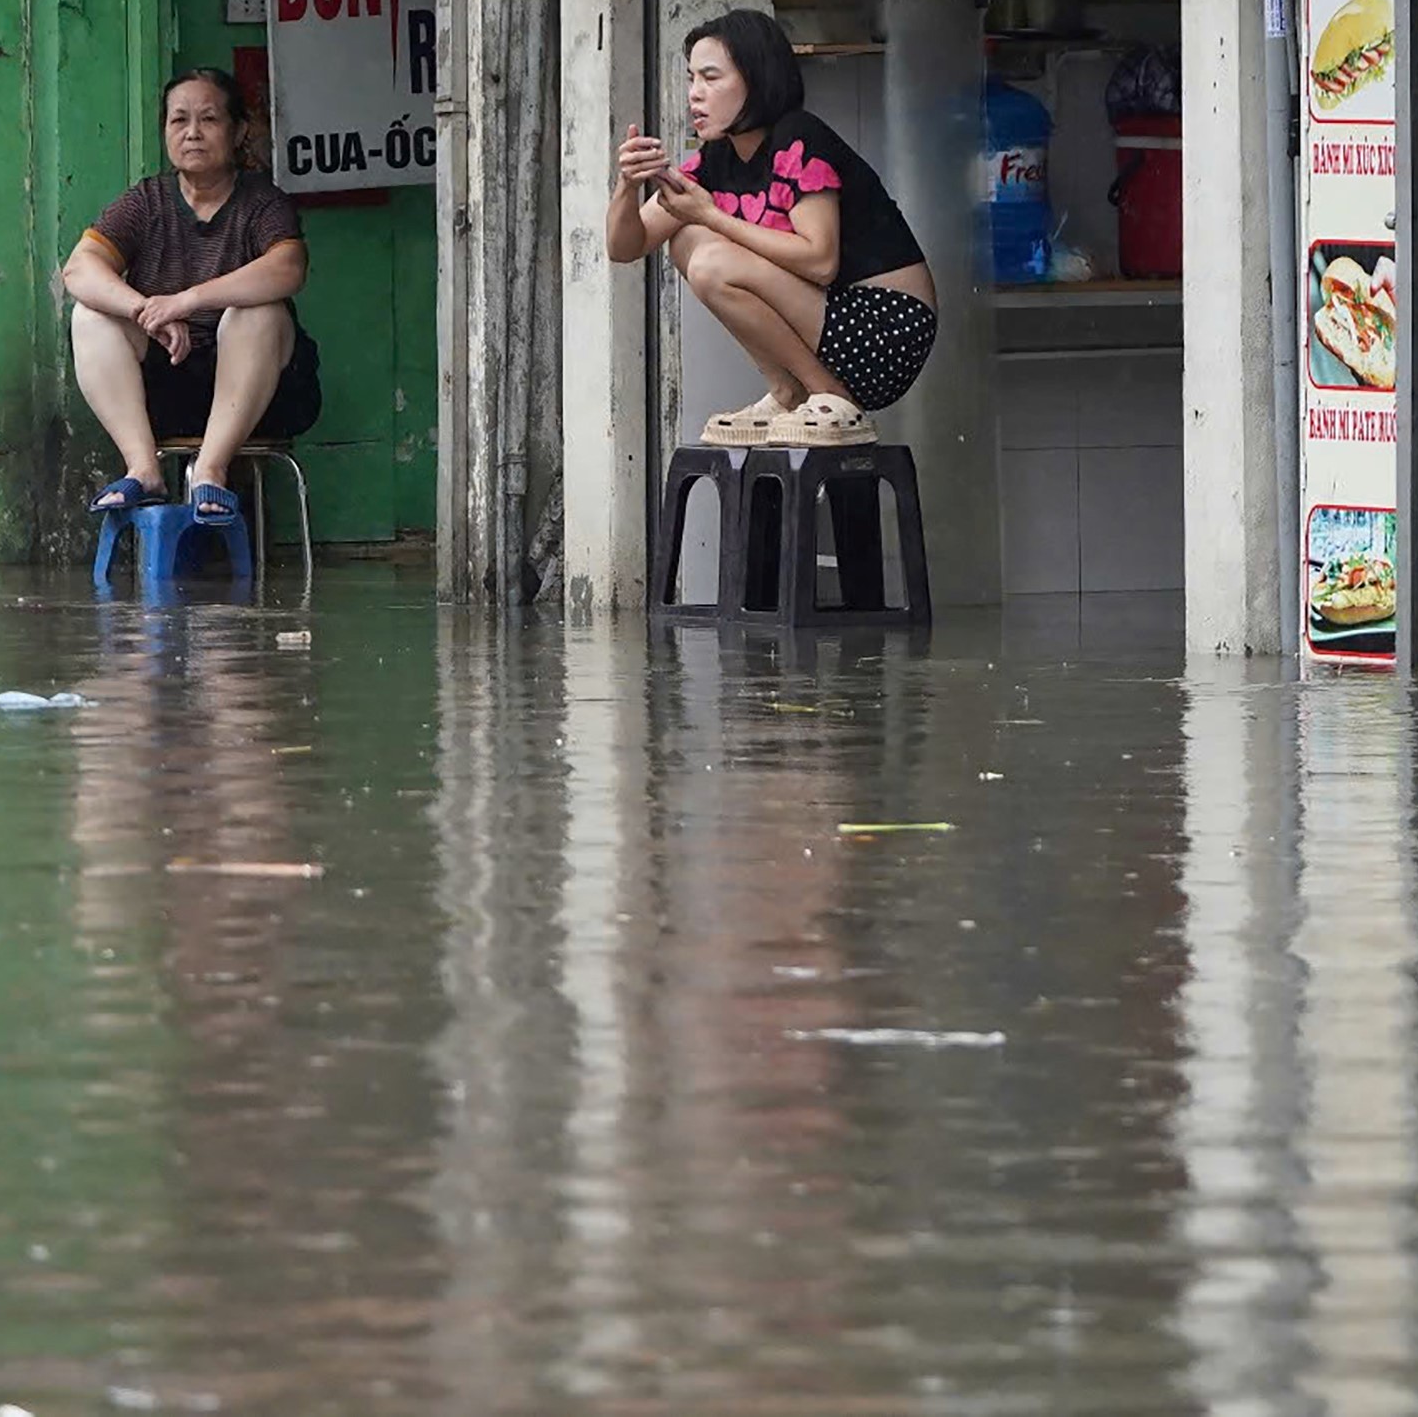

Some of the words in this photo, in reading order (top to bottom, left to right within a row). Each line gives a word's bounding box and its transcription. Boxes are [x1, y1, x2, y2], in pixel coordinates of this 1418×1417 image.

[1313, 135, 1341, 174] BÁNH
[1343, 135, 1354, 174] MÌ
[1356, 135, 1376, 175] XÚC
[1309, 398, 1336, 439] BÁNH
[1338, 401, 1349, 440] MÌ
[1352, 410, 1375, 441] PATE
